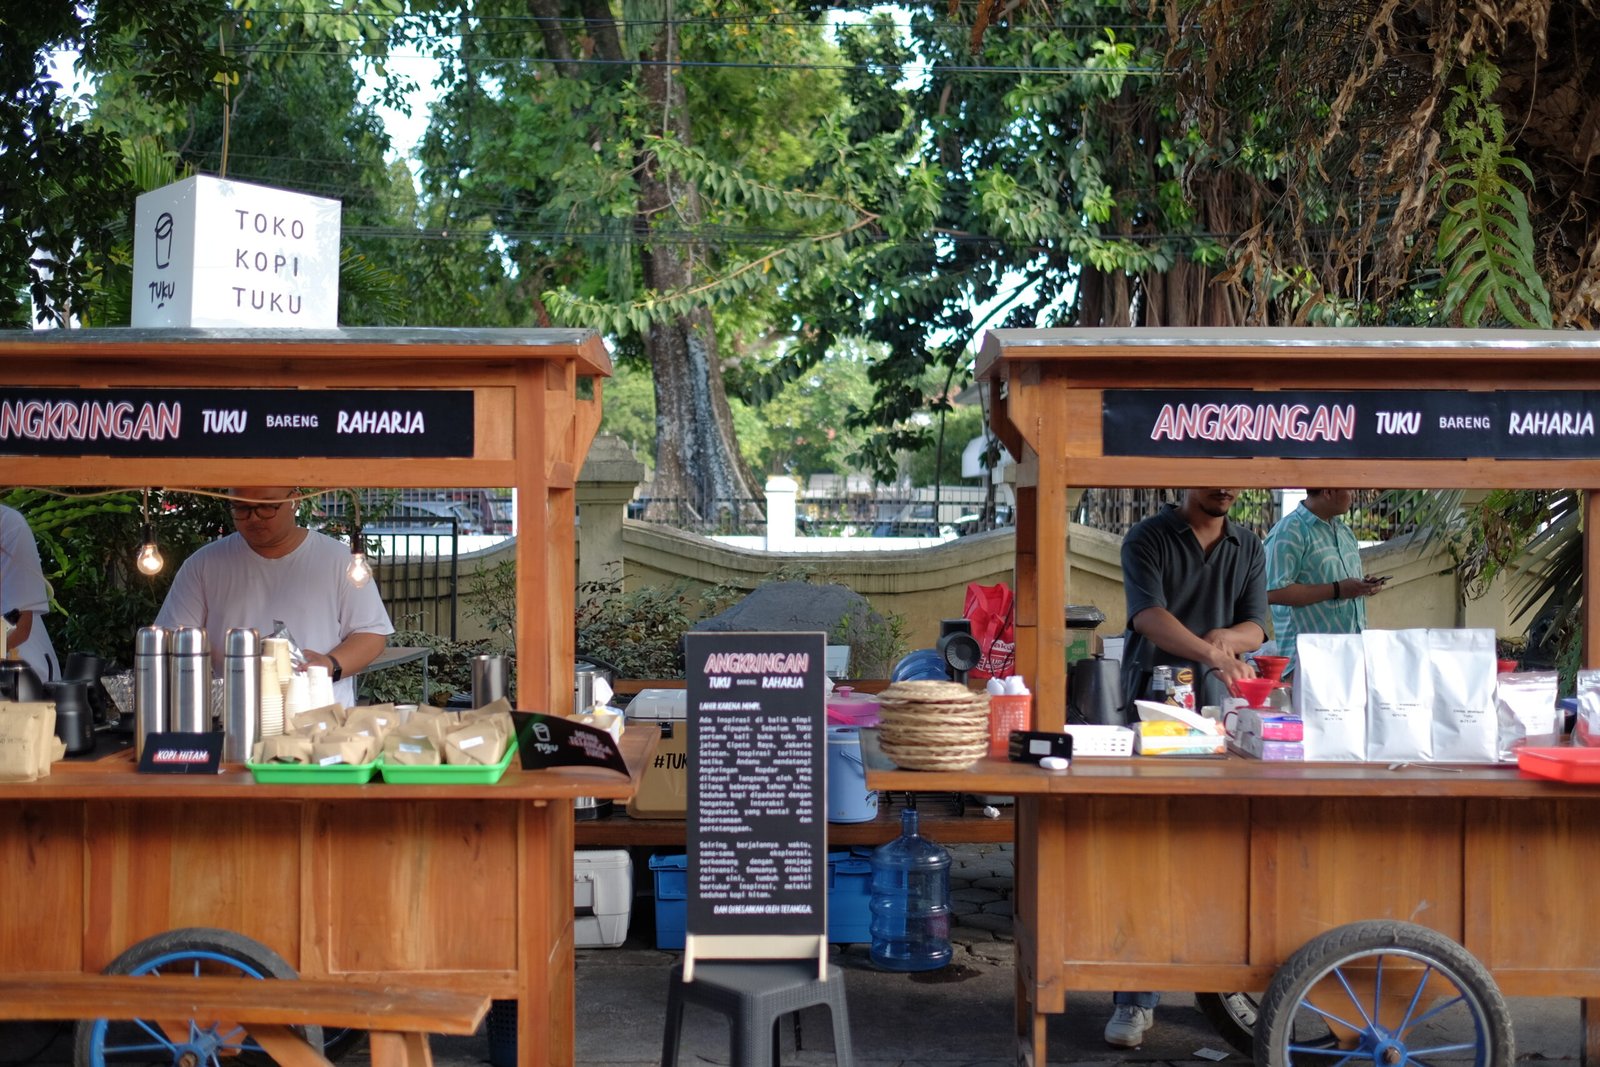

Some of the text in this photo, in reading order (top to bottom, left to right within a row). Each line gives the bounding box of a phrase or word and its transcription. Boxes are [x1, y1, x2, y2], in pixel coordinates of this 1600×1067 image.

[235, 209, 304, 239] TOKO
[235, 248, 298, 277] KOPI
[148, 281, 175, 304] TUKU
[232, 286, 301, 314] TUKU
[0, 401, 425, 440] NGKRINGAN TUKU BARENG RAHARJA
[1150, 403, 1595, 441] ANGKRINGAN TUKU BARENG RAHARJA
[703, 653, 809, 674] ANGKRINGAN
[709, 676, 732, 688] TUKU
[762, 676, 804, 688] RAHARJA
[716, 702, 742, 710] KARENA
[717, 717, 751, 725] inspirasi
[791, 717, 812, 725] mimpi
[699, 733, 727, 742] pertama
[534, 743, 559, 754] TUKU
[157, 750, 209, 760] KOPI HITAM
[773, 758, 812, 766] mendatangi
[699, 766, 739, 775] Angkringan
[699, 775, 730, 783] dilayani
[739, 775, 770, 783] langsung
[699, 783, 724, 791] Gilang
[729, 783, 761, 791] beberapa
[730, 791, 746, 800] kopi
[750, 791, 785, 800] dipadukan
[788, 791, 813, 800] dengan
[699, 800, 735, 808] hangatnya
[700, 808, 739, 816] Yogyakarta
[700, 841, 728, 849] Seiring
[736, 841, 779, 849] berjalannya
[700, 858, 813, 866] berkembang dengan menjaga
[746, 866, 778, 874] Semuanya
[730, 891, 746, 899] kopi
[714, 904, 728, 914] DAN
[728, 904, 764, 914] DIBESARKAN
[764, 904, 780, 914] OLEH
